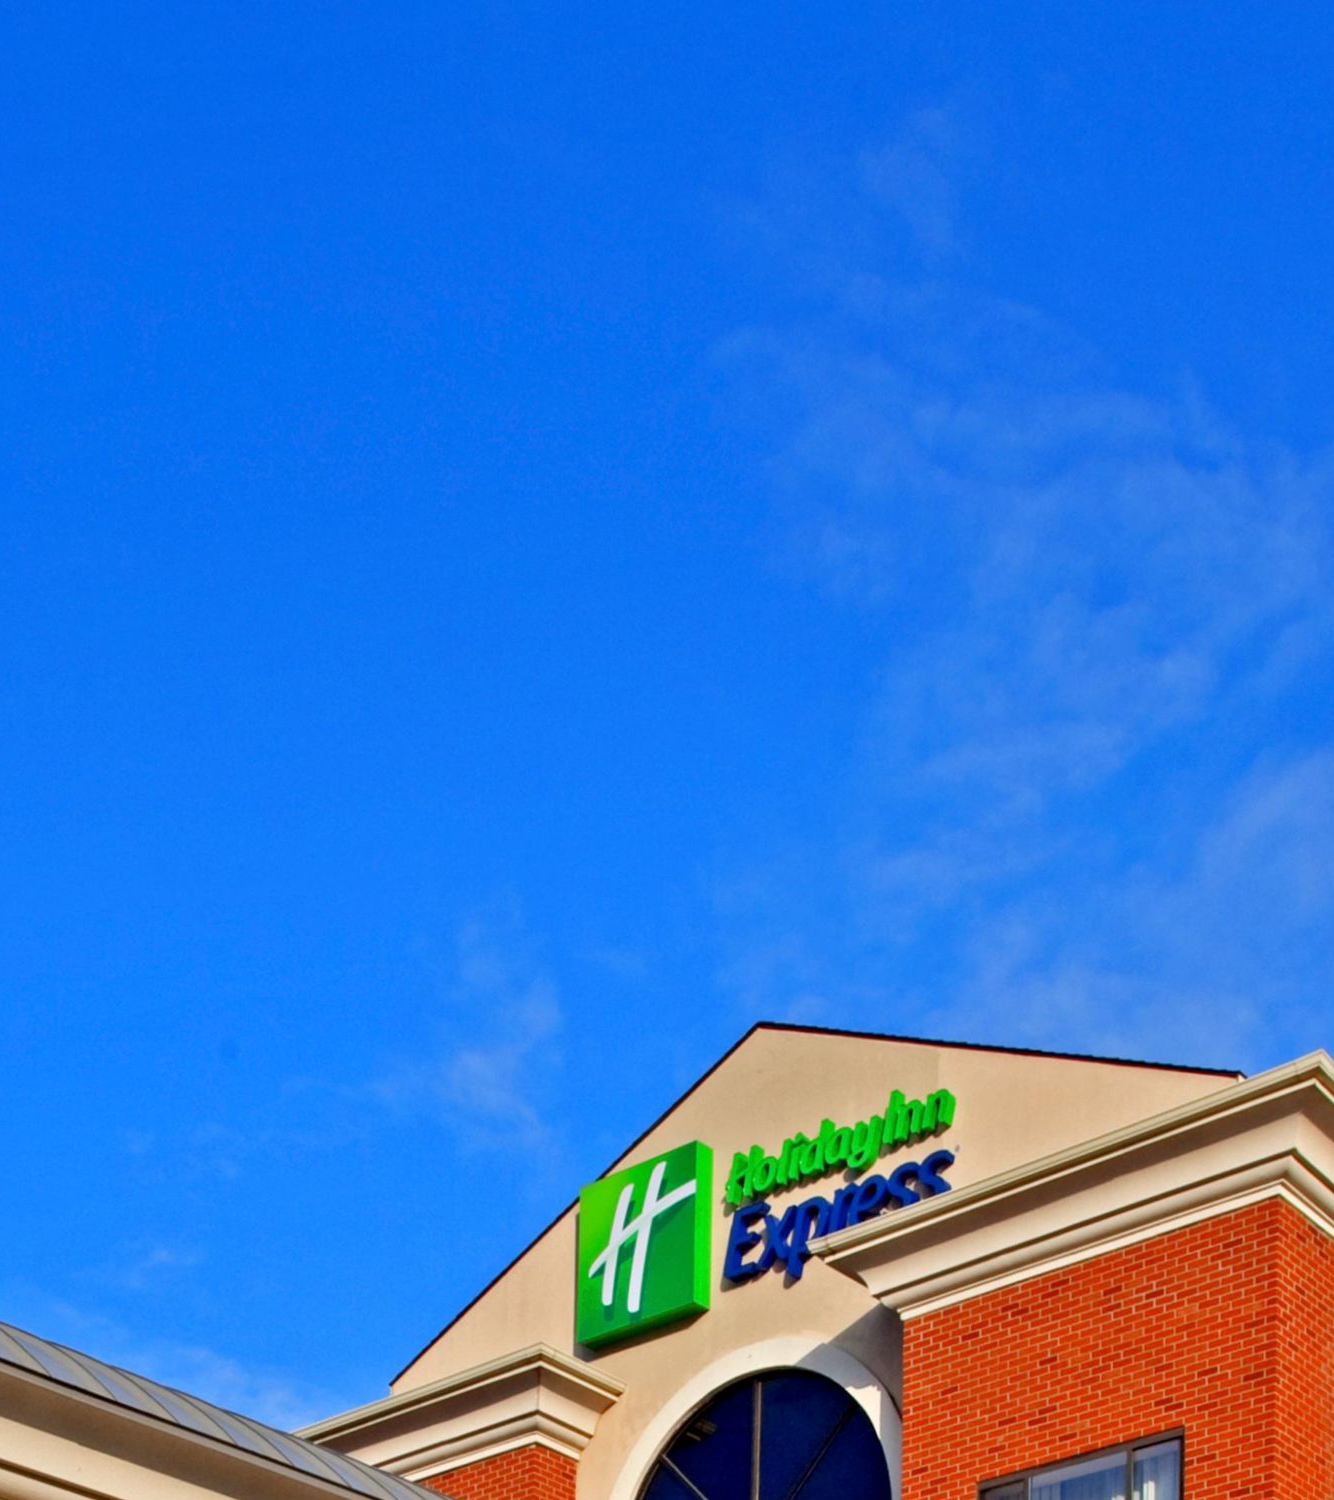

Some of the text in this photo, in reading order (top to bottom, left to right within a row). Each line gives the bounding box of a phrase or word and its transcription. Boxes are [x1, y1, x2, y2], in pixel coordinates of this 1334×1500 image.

[725, 1088, 956, 1206] Holiday Inn
[588, 1160, 696, 1313] H
[723, 1149, 955, 1281] Express
